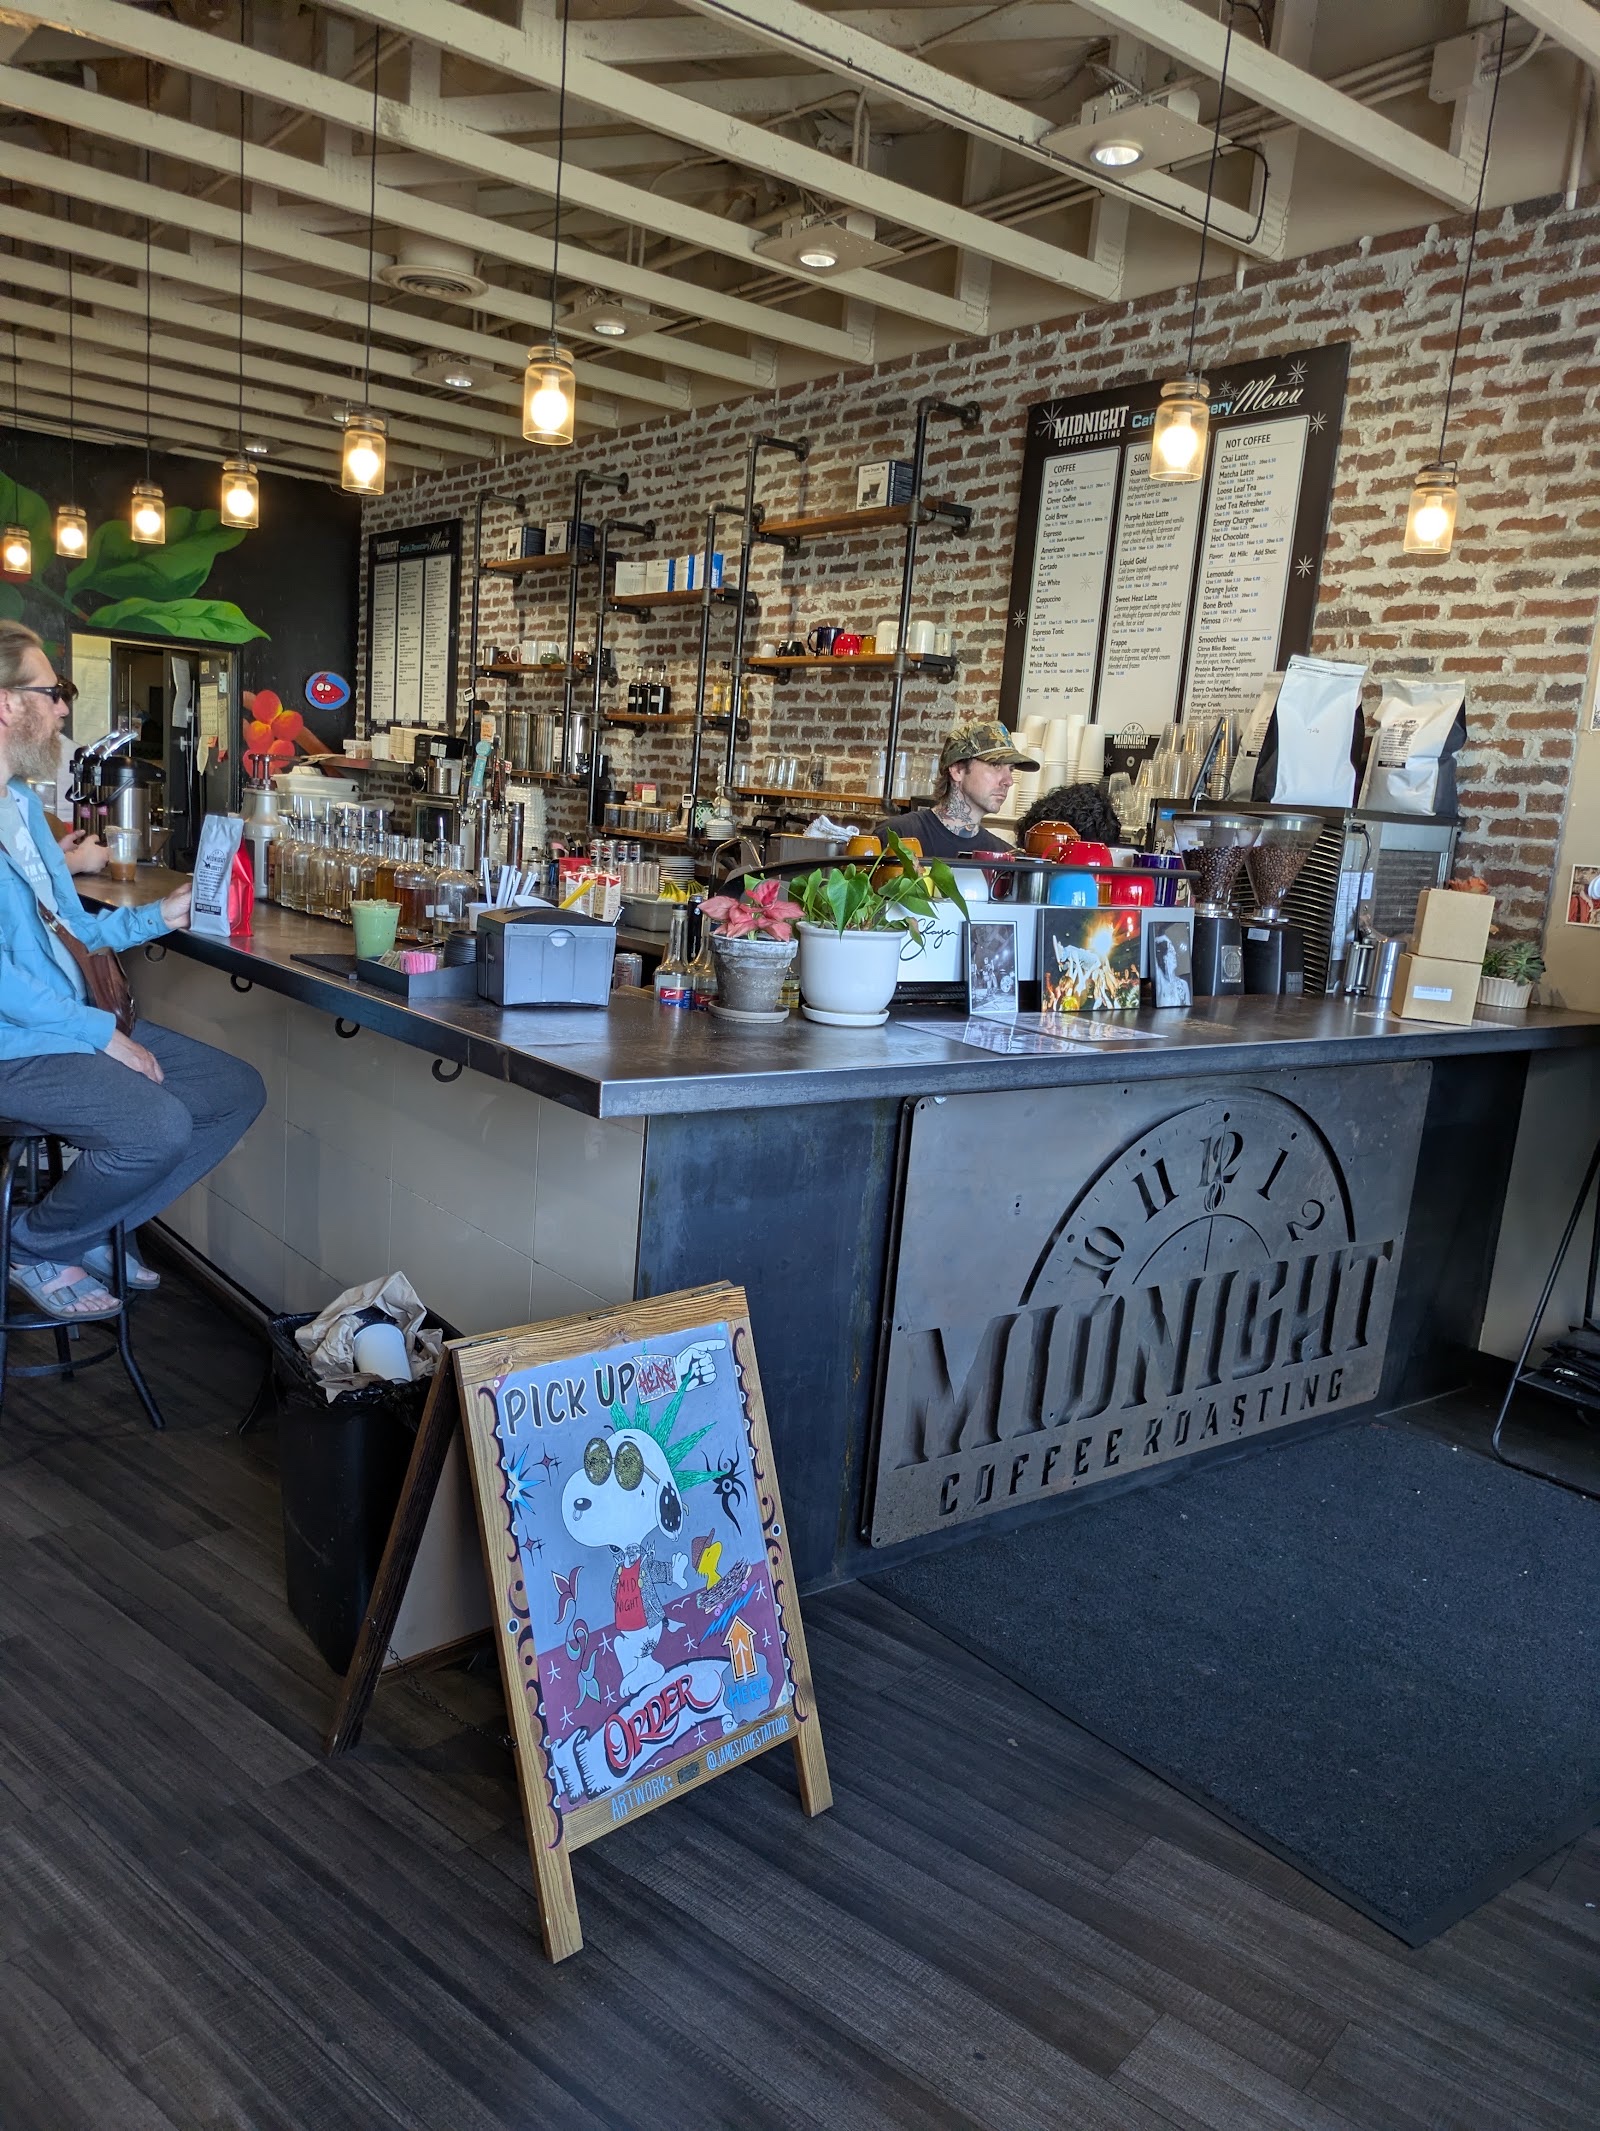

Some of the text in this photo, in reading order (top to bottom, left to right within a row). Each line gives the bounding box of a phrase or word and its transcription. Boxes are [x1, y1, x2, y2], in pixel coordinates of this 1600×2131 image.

[1132, 412, 1156, 428] Caf
[1232, 374, 1304, 414] Menu
[1054, 406, 1129, 439] MIDNIGHT
[1058, 429, 1120, 447] COFFEE ROASTING
[1226, 434, 1271, 448] NOT COFFEE
[1221, 455, 1233, 463] Chai
[1054, 464, 1076, 474] COFFEE
[1130, 468, 1148, 476] Shaken
[1219, 470, 1238, 479] Matcha
[1128, 484, 1143, 492] Midnight
[1144, 483, 1159, 491] Espresso
[1217, 487, 1232, 495] Loose
[1234, 484, 1245, 493] Leaf
[1134, 493, 1147, 501] poured
[1215, 503, 1226, 511] Iced
[1239, 499, 1265, 508] Refresher
[1125, 513, 1140, 522] Purple
[1142, 512, 1154, 520] Haze
[1213, 516, 1254, 527] Energy Charger
[1141, 528, 1157, 537] Midnight
[1223, 532, 1249, 540] Chocolate
[1120, 558, 1134, 567] Liquid
[1136, 566, 1149, 574] topped
[1158, 564, 1168, 572] maple
[1207, 569, 1234, 578] Lemonade
[1204, 585, 1238, 596] Orange Juice
[1036, 596, 1061, 604] Cappuccino
[1150, 602, 1160, 610] maple
[1033, 629, 1051, 637] Espresso
[1111, 639, 1127, 647] Frappe
[1198, 635, 1226, 643] Smoothies
[1112, 734, 1150, 745] MIDNIGHT
[1197, 1132, 1244, 1188] 12
[1286, 1199, 1325, 1242] 2
[894, 1240, 1394, 1470] MIDNIGHT
[503, 1377, 588, 1436] PICK
[594, 1361, 637, 1408] UP
[940, 1368, 1344, 1516] COFFEE ROASTING
[619, 1578, 636, 1593] MID
[617, 1597, 638, 1612] NIGHT
[727, 1676, 769, 1710] HERE
[604, 1669, 724, 1777] ORDER
[611, 1714, 790, 1822] ARTWORK: @JAMESLOVESTATTOOS
